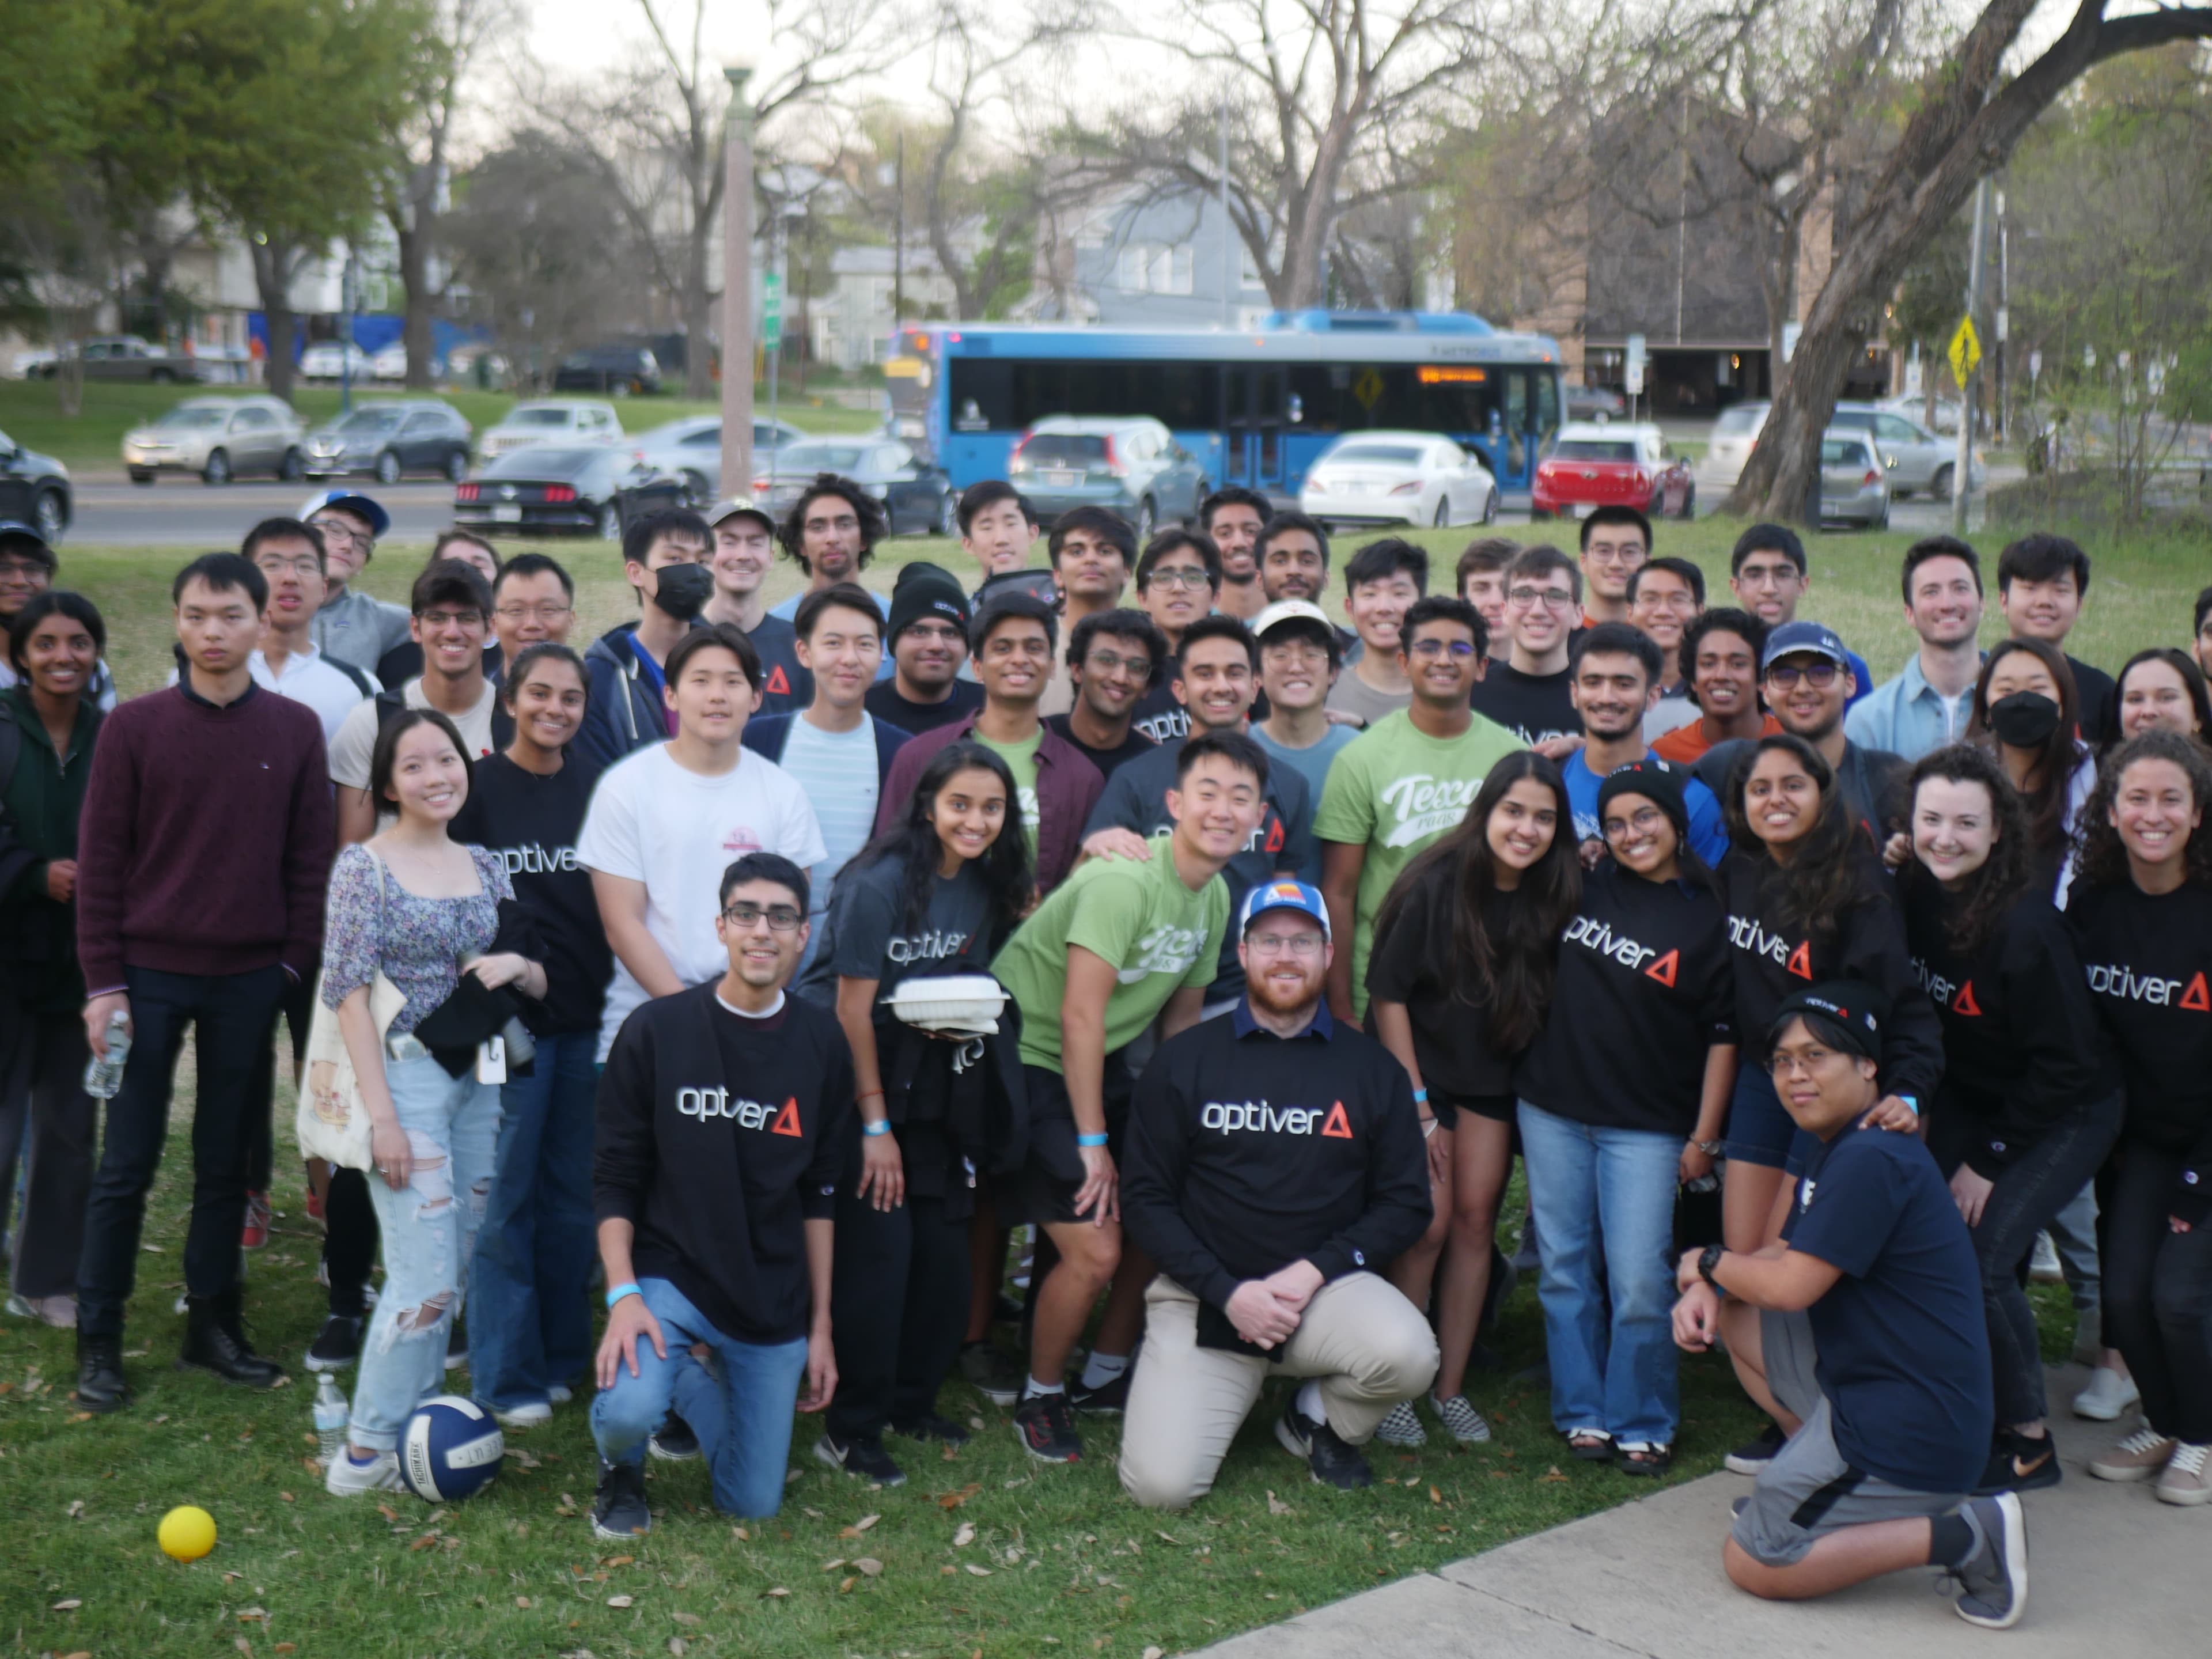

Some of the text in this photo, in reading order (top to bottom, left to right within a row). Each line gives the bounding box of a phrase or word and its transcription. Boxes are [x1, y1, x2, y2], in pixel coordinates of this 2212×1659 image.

[1381, 774, 1484, 823] Texa
[1562, 914, 1656, 970] ptiver
[2086, 964, 2183, 1006] ptiver
[677, 1084, 778, 1131] optver
[1201, 1099, 1324, 1136] optiver
